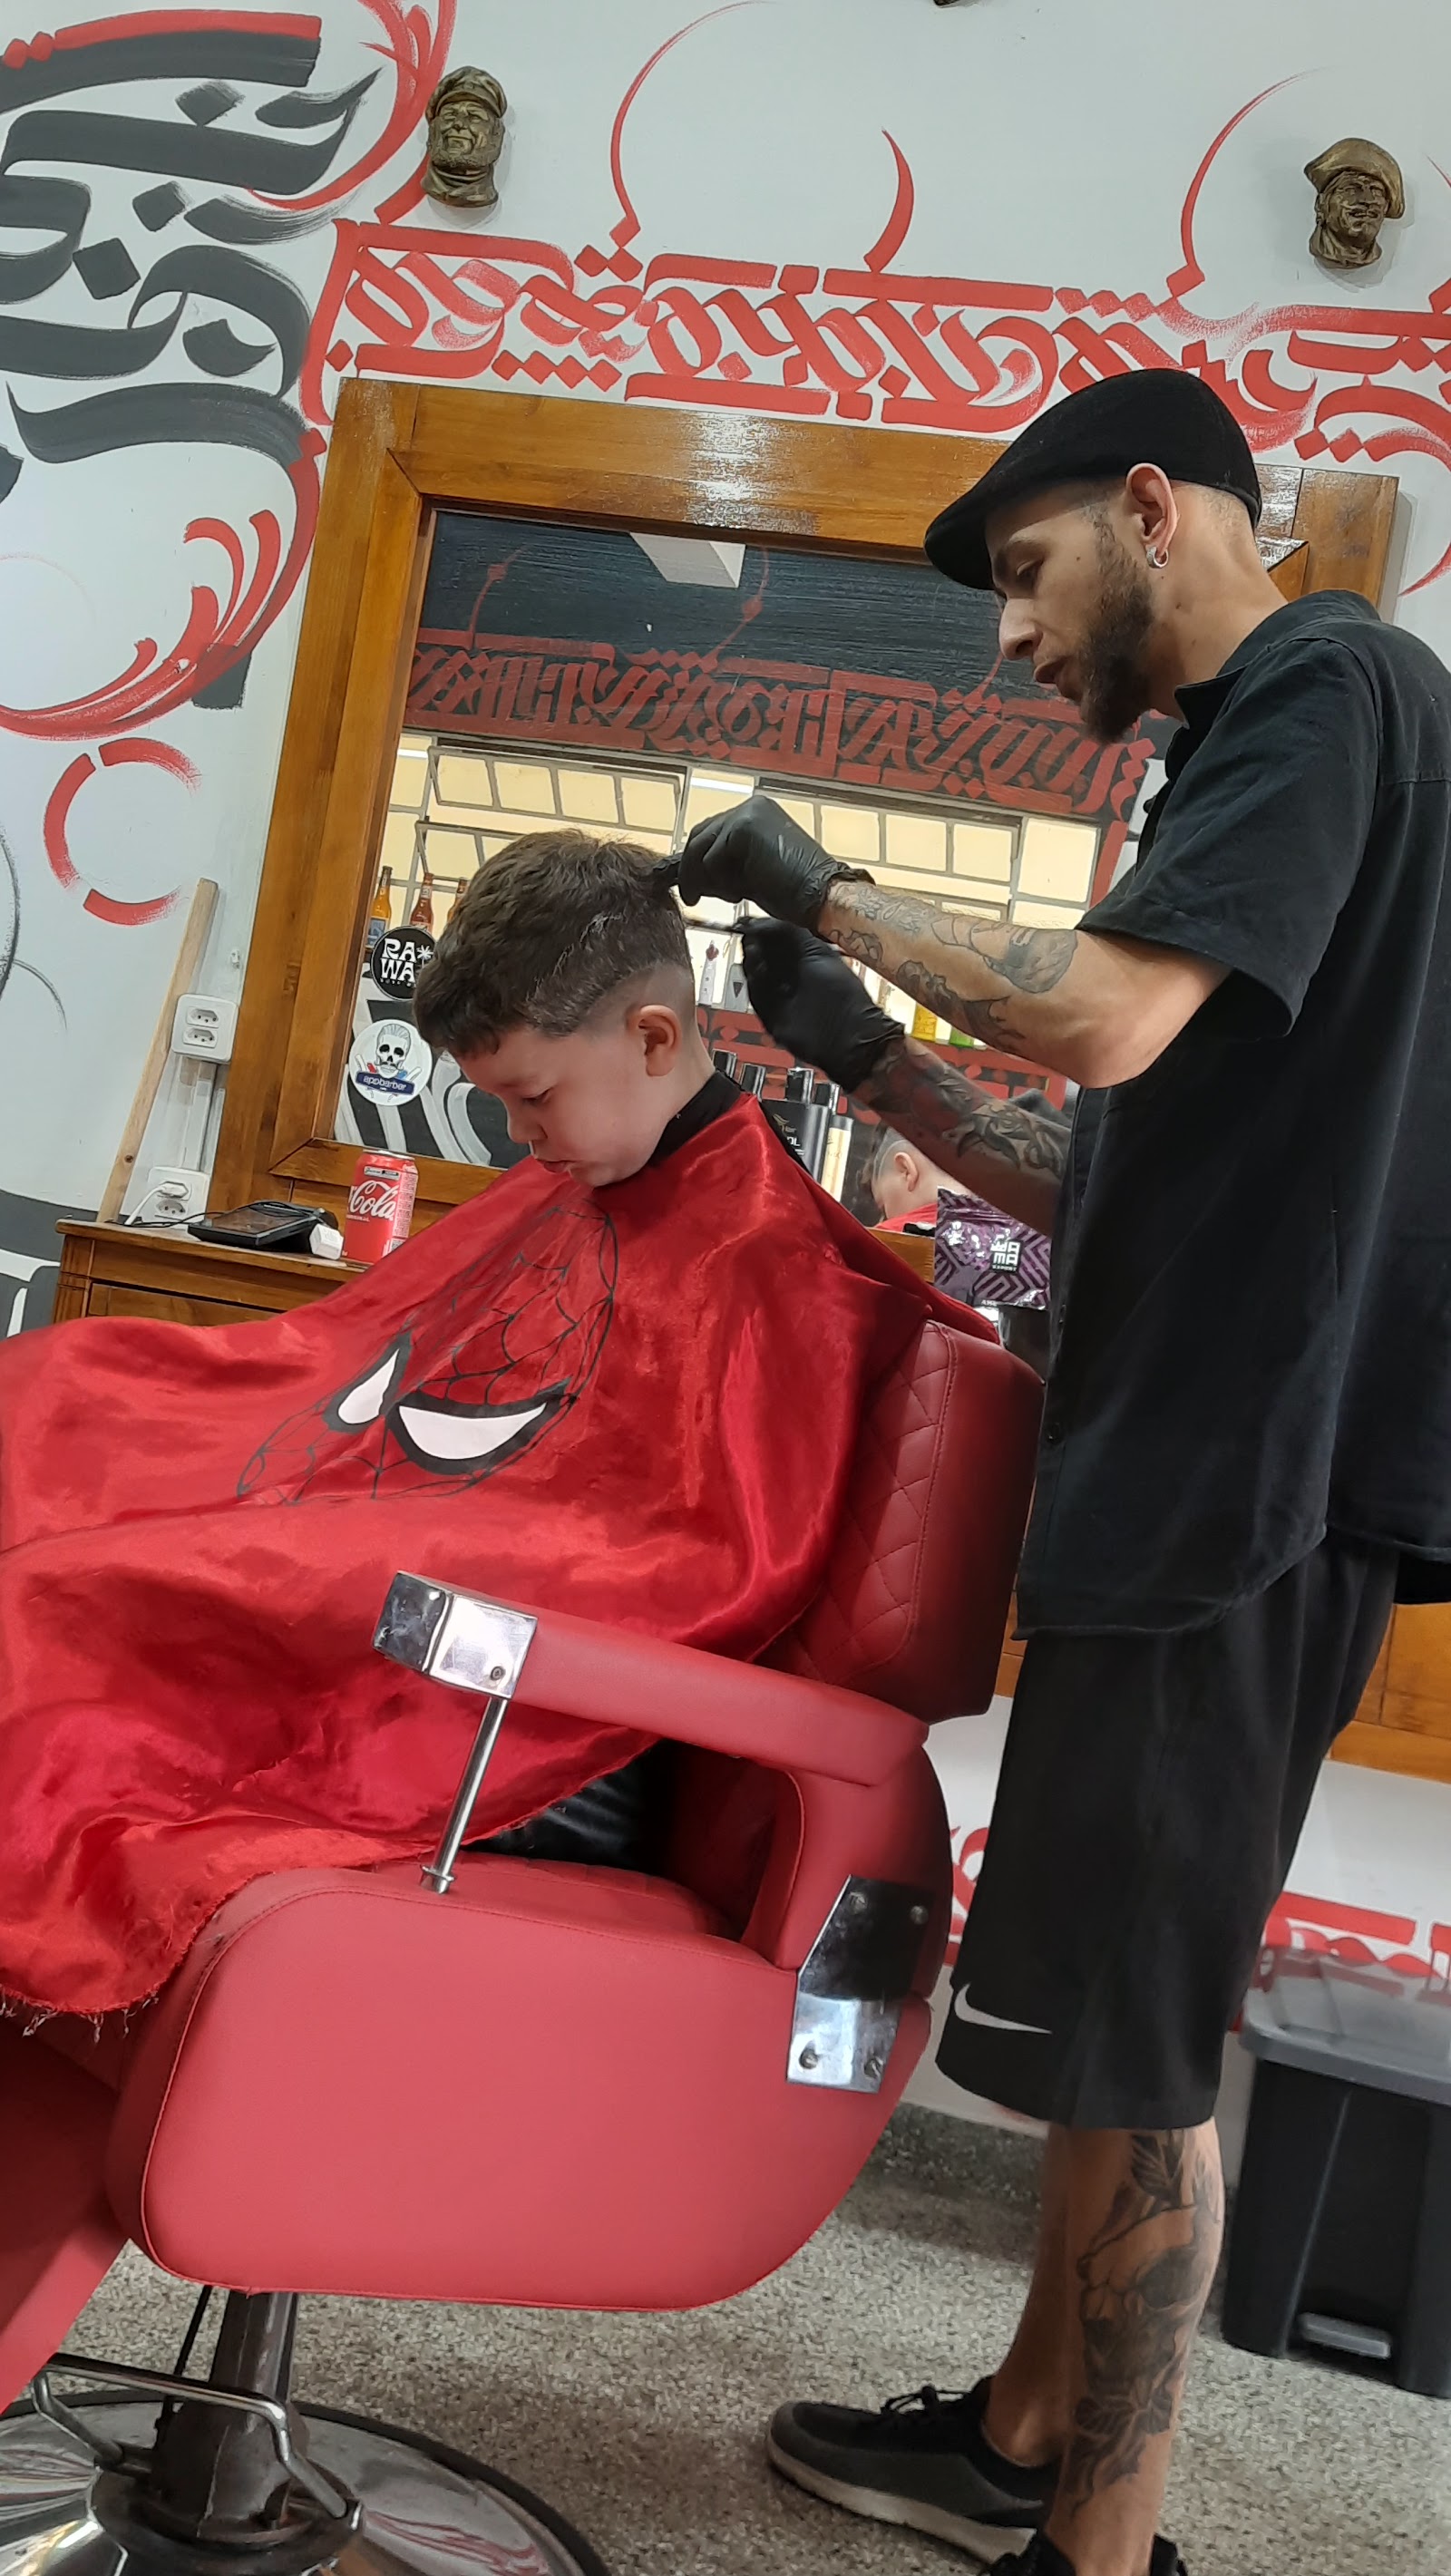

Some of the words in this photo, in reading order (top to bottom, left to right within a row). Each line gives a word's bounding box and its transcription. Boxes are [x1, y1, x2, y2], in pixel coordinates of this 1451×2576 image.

[382, 938, 417, 964] RA
[380, 957, 416, 983] WA
[350, 1180, 400, 1220] Cola
